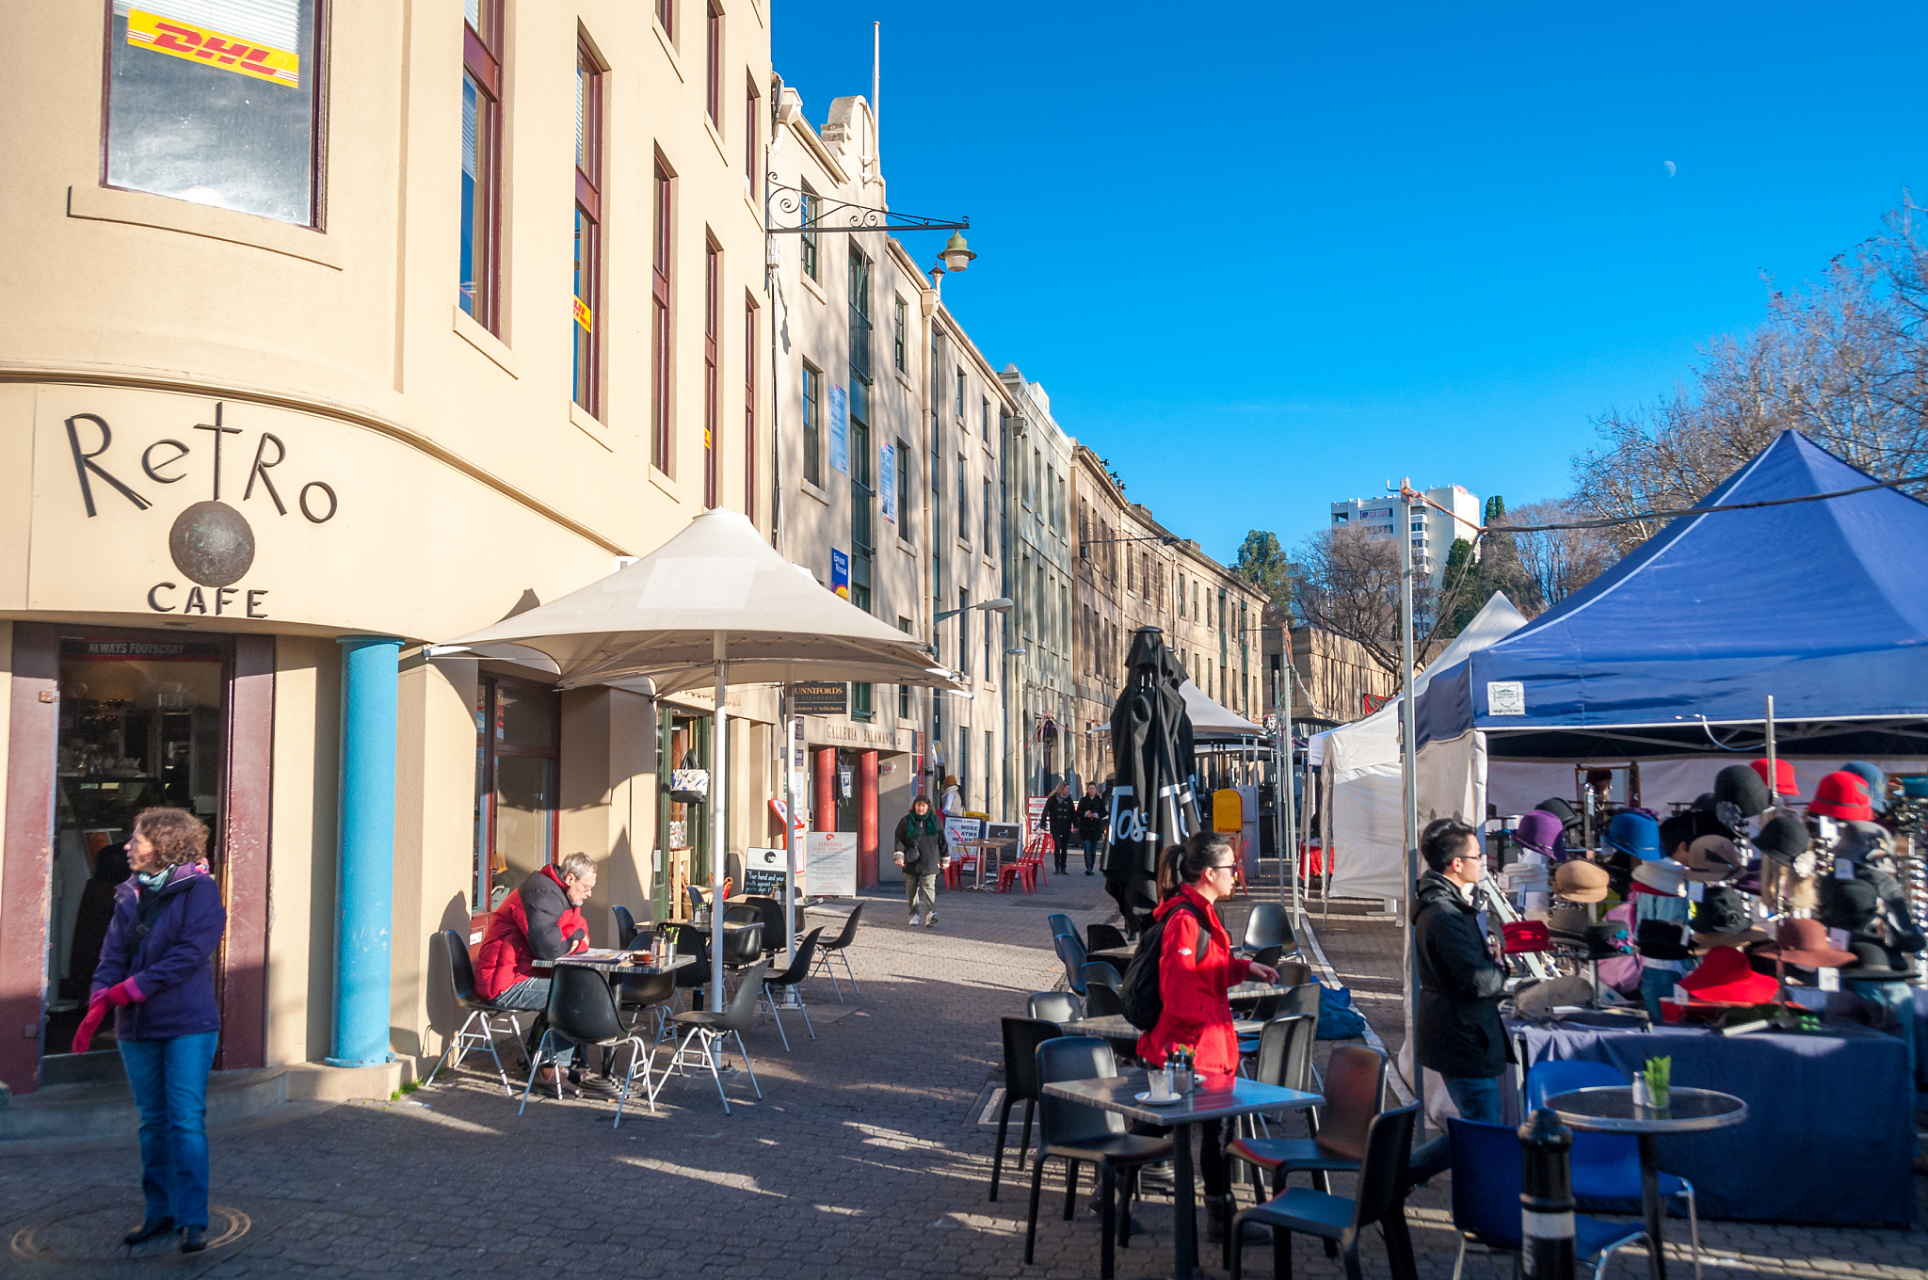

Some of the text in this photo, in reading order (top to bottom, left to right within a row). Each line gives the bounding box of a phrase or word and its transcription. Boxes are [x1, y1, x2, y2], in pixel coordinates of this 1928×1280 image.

[152, 22, 278, 76] DHL
[573, 299, 588, 325] HL
[147, 582, 269, 619] CAFE
[88, 642, 185, 655] ALWAYS FOOTSCRAY
[794, 686, 843, 695] UNNIFORDS
[826, 724, 858, 741] GALLERIA
